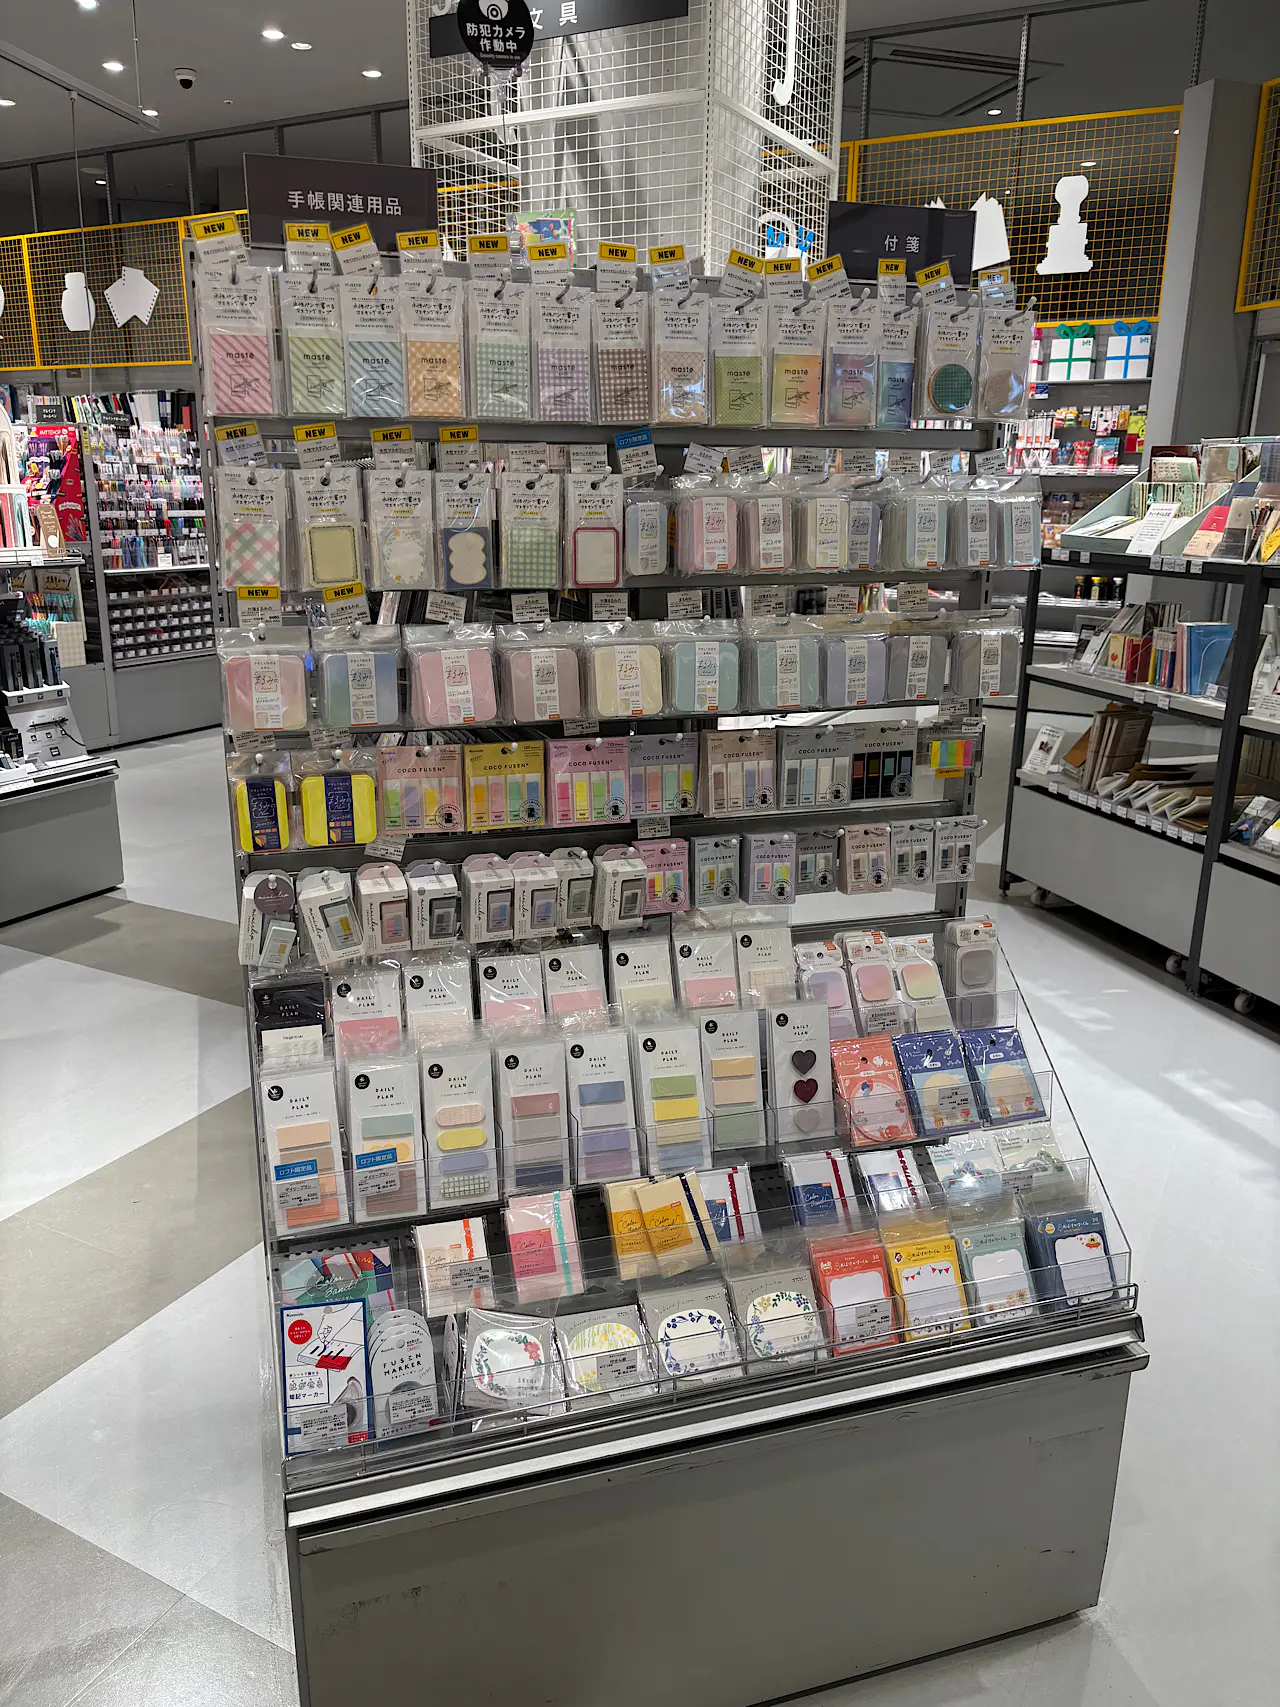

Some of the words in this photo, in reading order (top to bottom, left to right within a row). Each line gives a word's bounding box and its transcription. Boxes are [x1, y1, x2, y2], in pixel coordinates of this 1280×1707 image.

[466, 23, 526, 39] 防犯カメラ
[479, 39, 517, 53] 作動中
[287, 190, 402, 216] 手帳関連用品
[203, 222, 225, 235] NEW
[297, 229, 318, 239] NEW
[341, 232, 361, 244] NEW
[408, 236, 428, 246] NEW
[478, 239, 499, 249] NEW
[884, 234, 920, 254] 付箋
[538, 247, 557, 257] NEW
[608, 248, 628, 258] NEW
[657, 249, 676, 259] NEW
[737, 255, 756, 268] NEW
[773, 262, 792, 271] NEW
[815, 261, 834, 275] NEW
[885, 263, 899, 271] NEW
[226, 427, 247, 439] NEW
[305, 427, 325, 438] NEW
[382, 431, 402, 440] NEW
[449, 430, 469, 439] NEW
[247, 589, 269, 597] NEW
[334, 587, 354, 597] NEW
[289, 1096, 310, 1104] DAILY
[291, 1103, 310, 1111] PLAN
[360, 1154, 393, 1164] ロフト限定品
[279, 1165, 313, 1176] ロフト限定品
[315, 1274, 344, 1289] Color
[383, 1352, 421, 1369] FUSEN
[384, 1360, 422, 1376] MARKER
